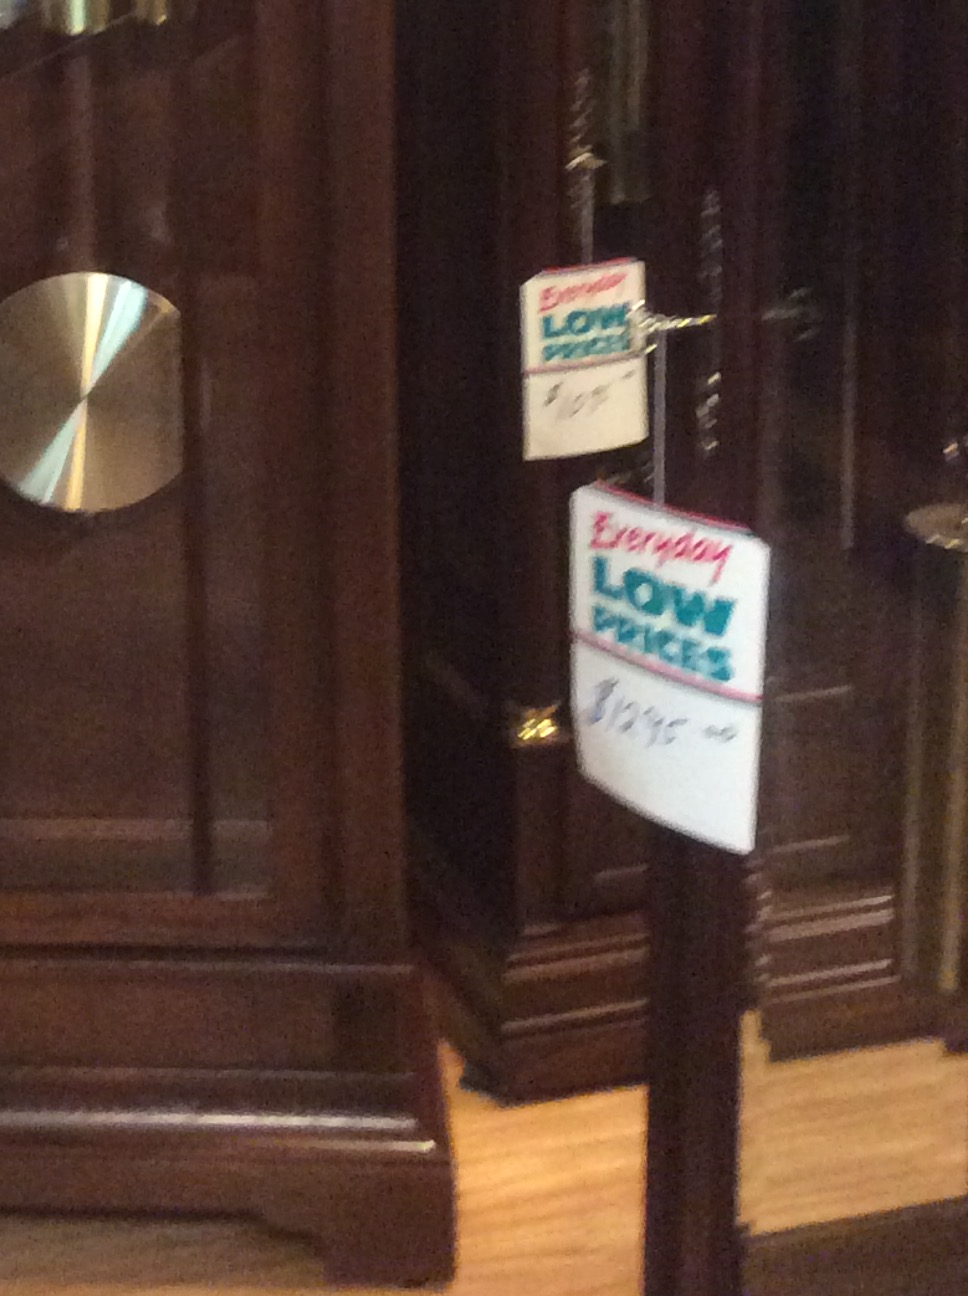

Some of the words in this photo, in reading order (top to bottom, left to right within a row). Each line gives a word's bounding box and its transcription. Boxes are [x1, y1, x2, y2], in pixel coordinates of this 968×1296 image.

[542, 301, 630, 340] LOW
[590, 510, 733, 586] Everyday
[590, 555, 736, 637] LOW
[591, 604, 735, 682] PRICES
